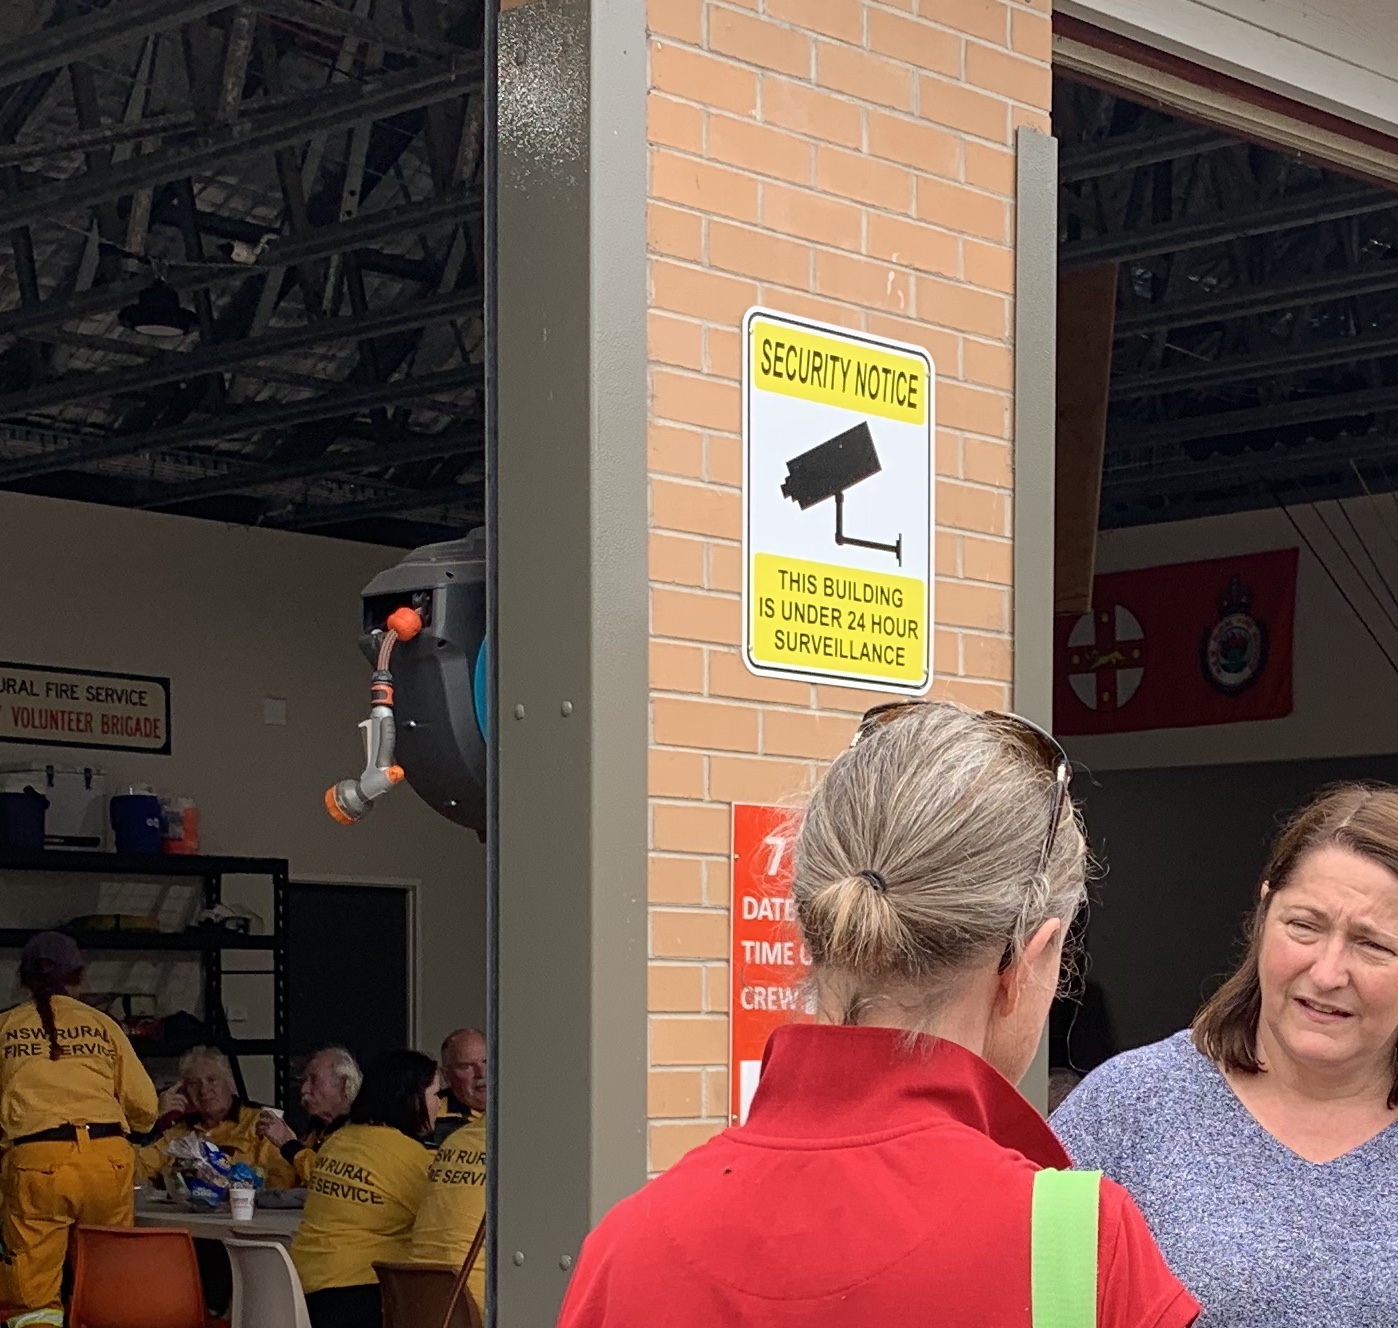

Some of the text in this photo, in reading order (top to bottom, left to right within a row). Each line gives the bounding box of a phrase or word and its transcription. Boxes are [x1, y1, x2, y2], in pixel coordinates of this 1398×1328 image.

[761, 338, 919, 409] SECURITY NOTICE
[778, 569, 904, 608] THIS BUILDING
[759, 597, 919, 640] IS UNDER 24 HOUR
[774, 629, 906, 667] SURVEILLANCE
[46, 682, 79, 701] FIRE
[86, 685, 148, 707] SERVICE
[12, 706, 161, 739] VOLUNTEER BRIGADE
[741, 940, 794, 965] TIME
[6, 1027, 46, 1041] NSW
[4, 1043, 117, 1061] FIRE ERVICE
[456, 1149, 486, 1166] RUR
[325, 1159, 375, 1188] RURAL
[442, 1169, 486, 1186] SERVI
[315, 1177, 385, 1205] SERVICE
